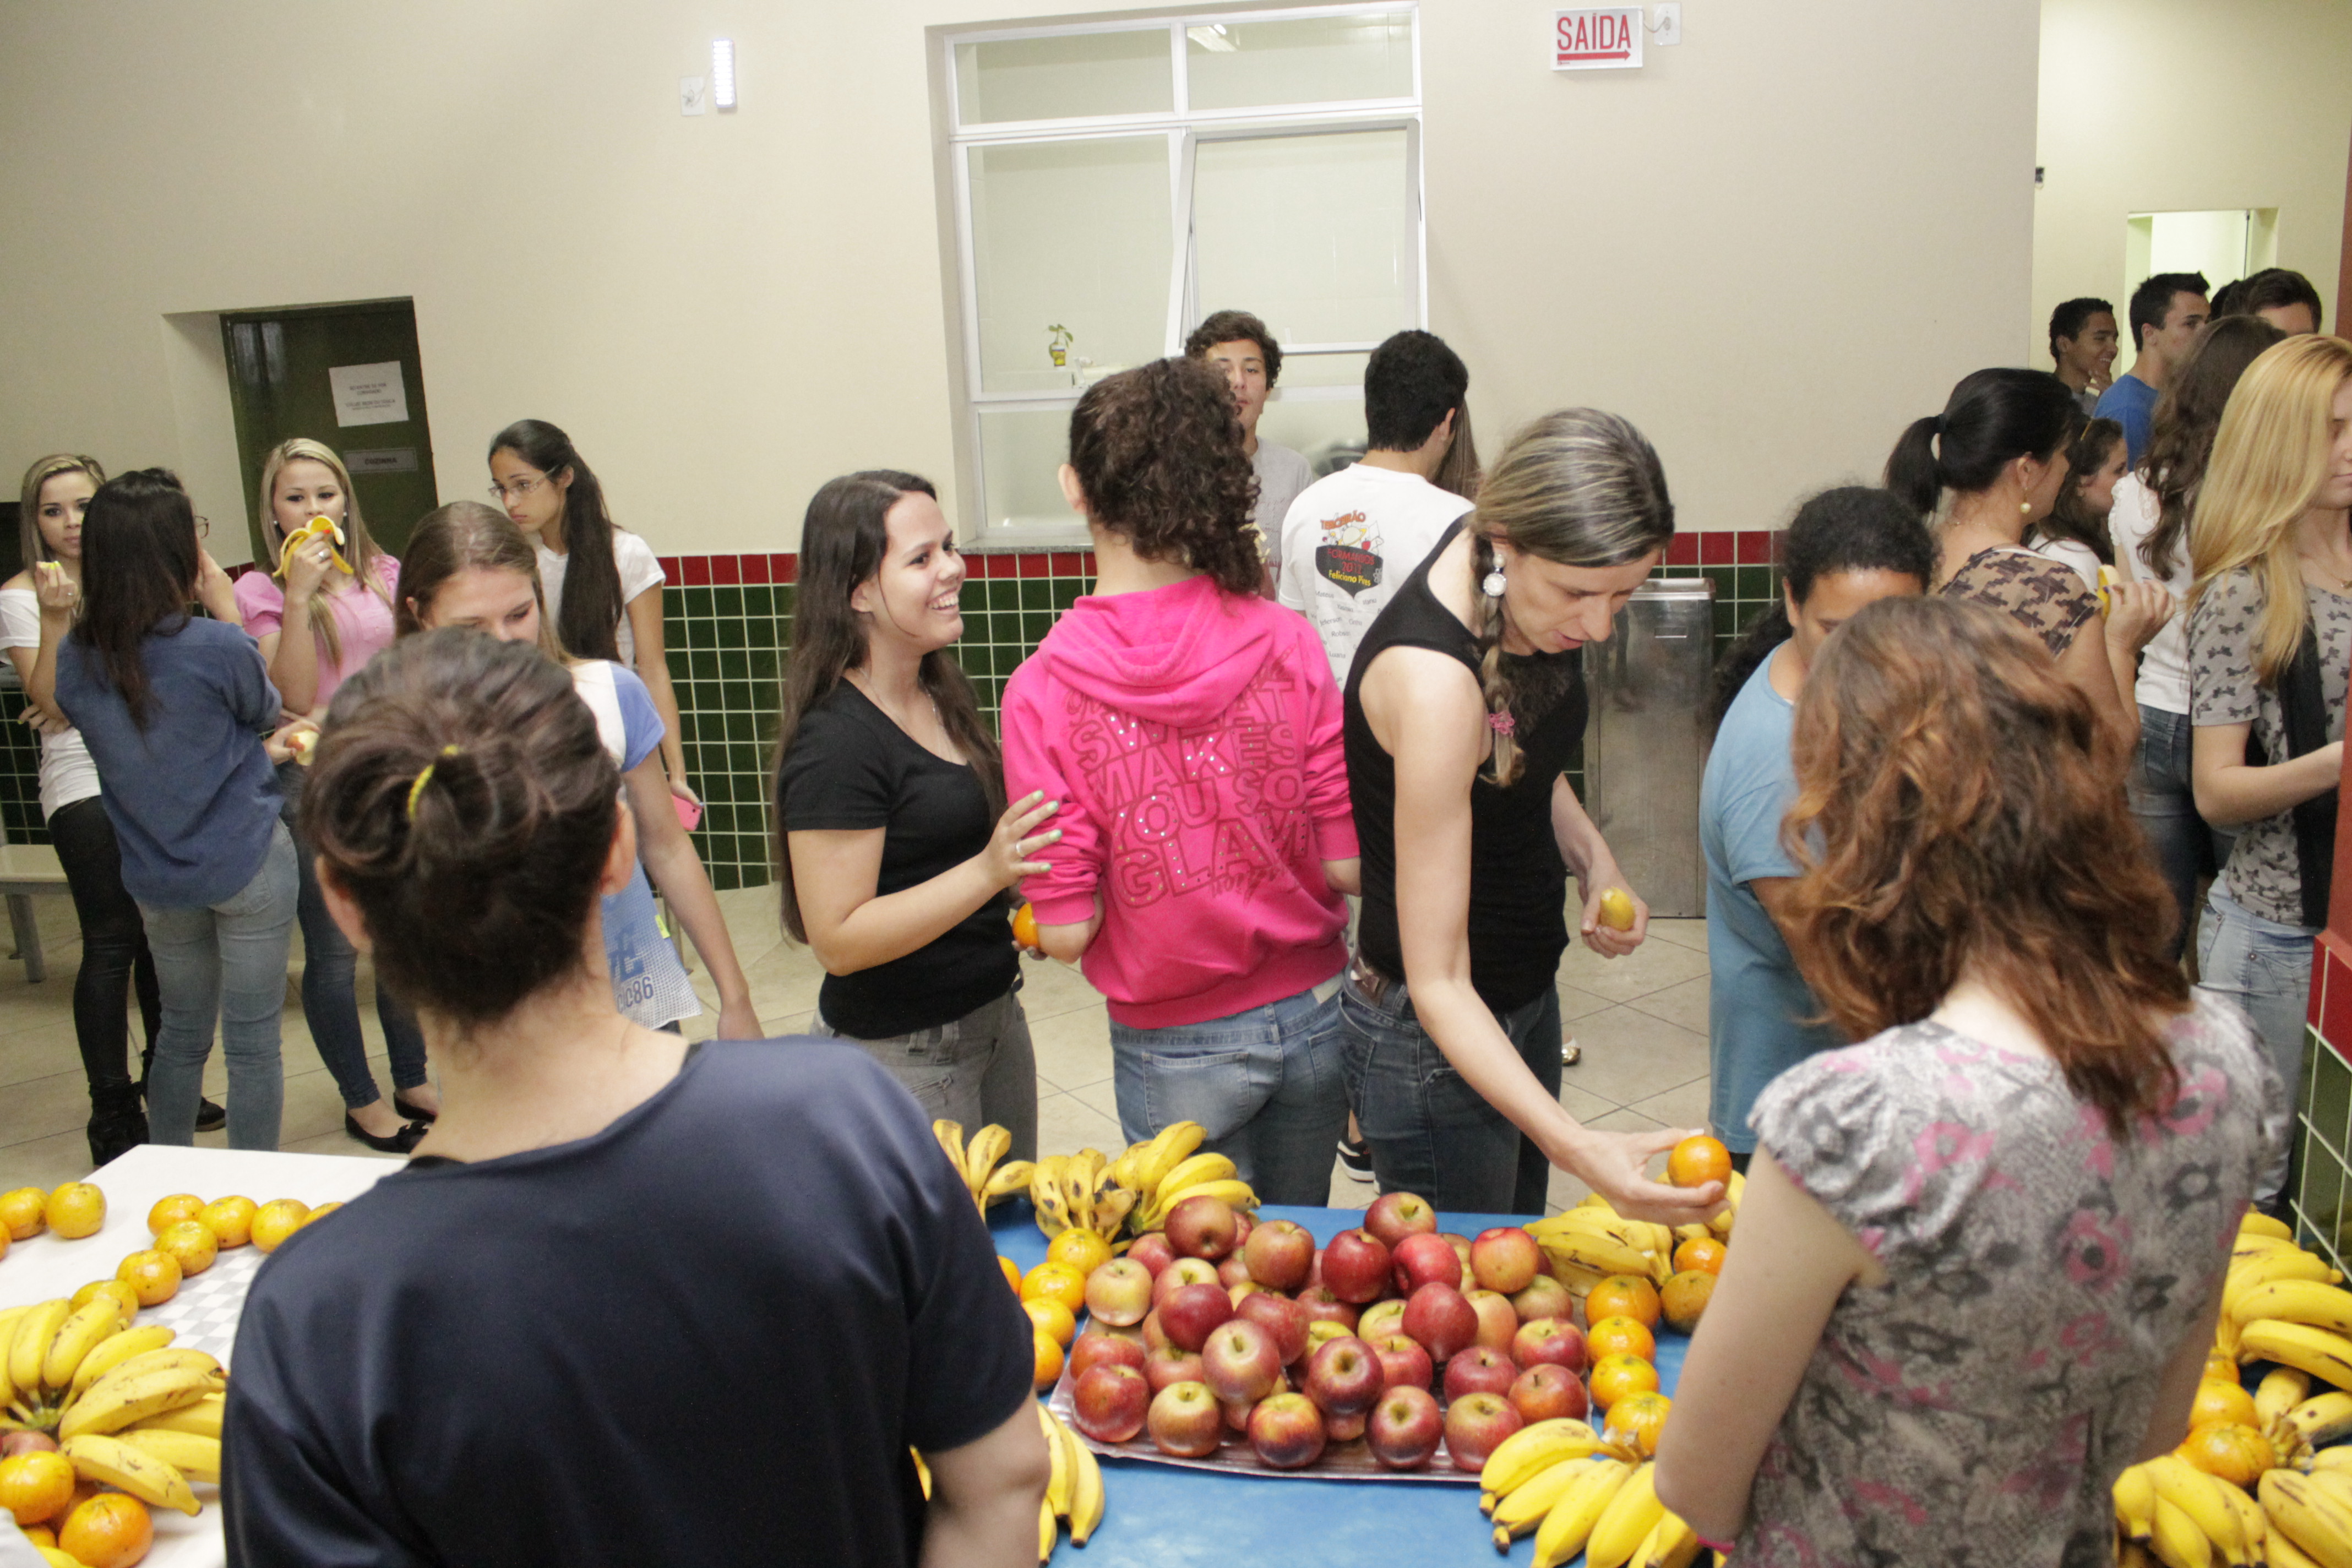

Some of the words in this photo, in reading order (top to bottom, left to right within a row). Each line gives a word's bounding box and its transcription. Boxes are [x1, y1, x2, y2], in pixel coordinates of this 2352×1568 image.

[1557, 13, 1631, 51] SAÍDA
[1320, 509, 1366, 530] TERCEIRÃO
[1327, 548, 1375, 565] FORMANDOS
[1329, 569, 1358, 583] Feliciano
[1358, 575, 1371, 586] Pires
[1315, 590, 1334, 598] Mateus
[1110, 775, 1221, 854] YOU
[1231, 767, 1308, 817] SO
[1113, 810, 1313, 908] GLAM
